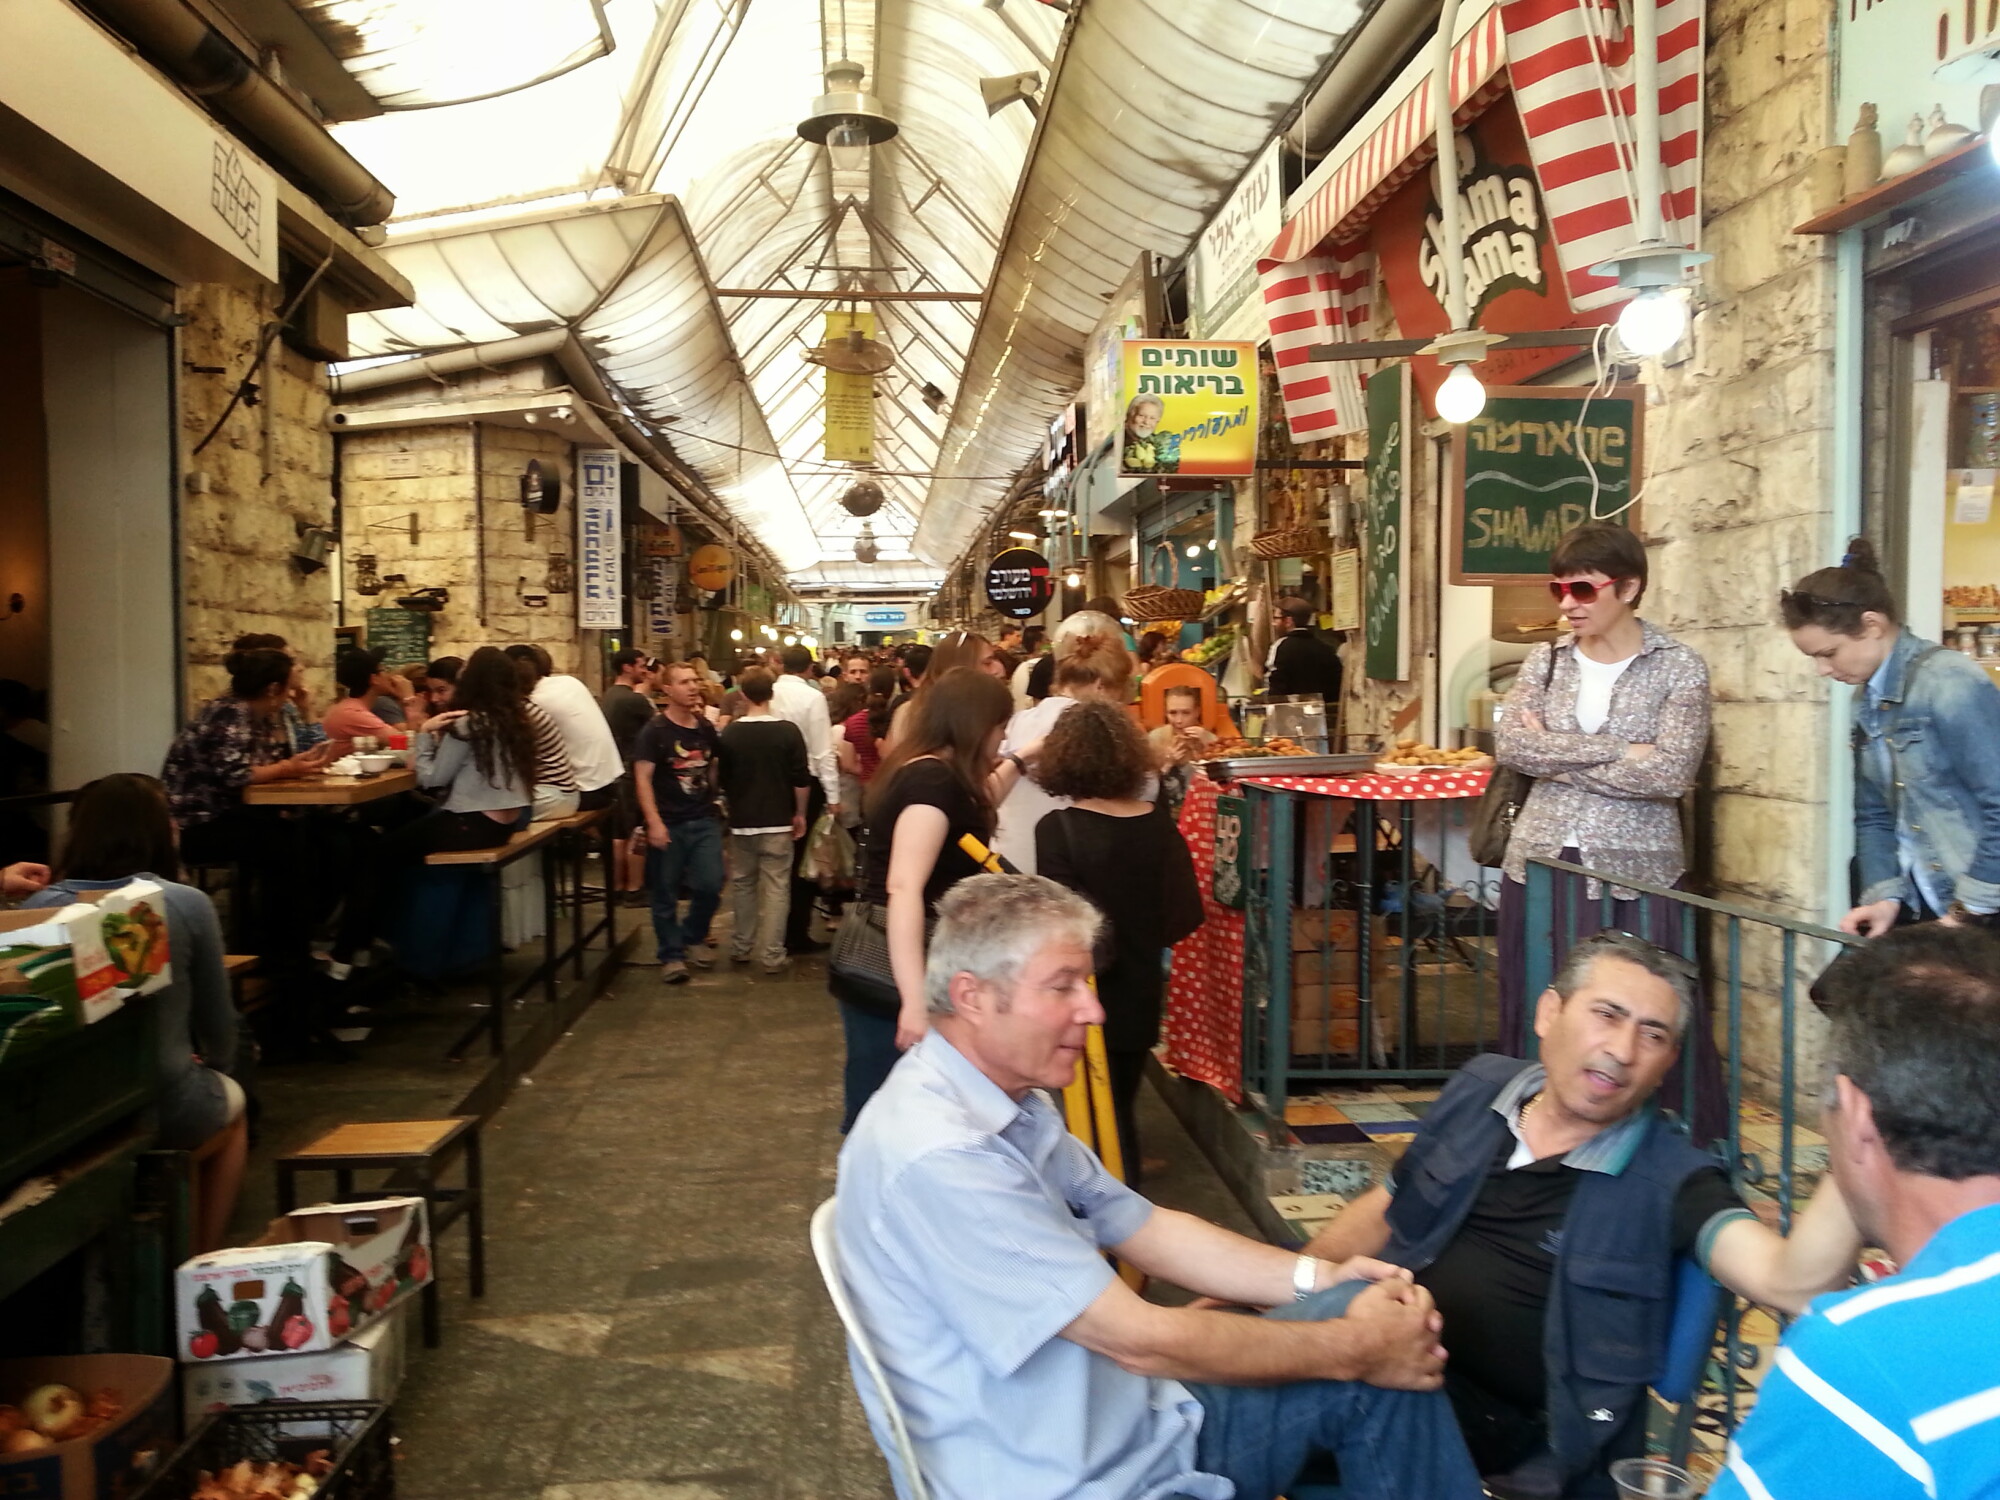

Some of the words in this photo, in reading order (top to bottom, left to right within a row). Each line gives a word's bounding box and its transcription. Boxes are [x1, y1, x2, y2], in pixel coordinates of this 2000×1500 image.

[1141, 348, 1238, 368] שותים
[1138, 374, 1244, 395] בריאות
[1467, 503, 1623, 553] SHAWAR
